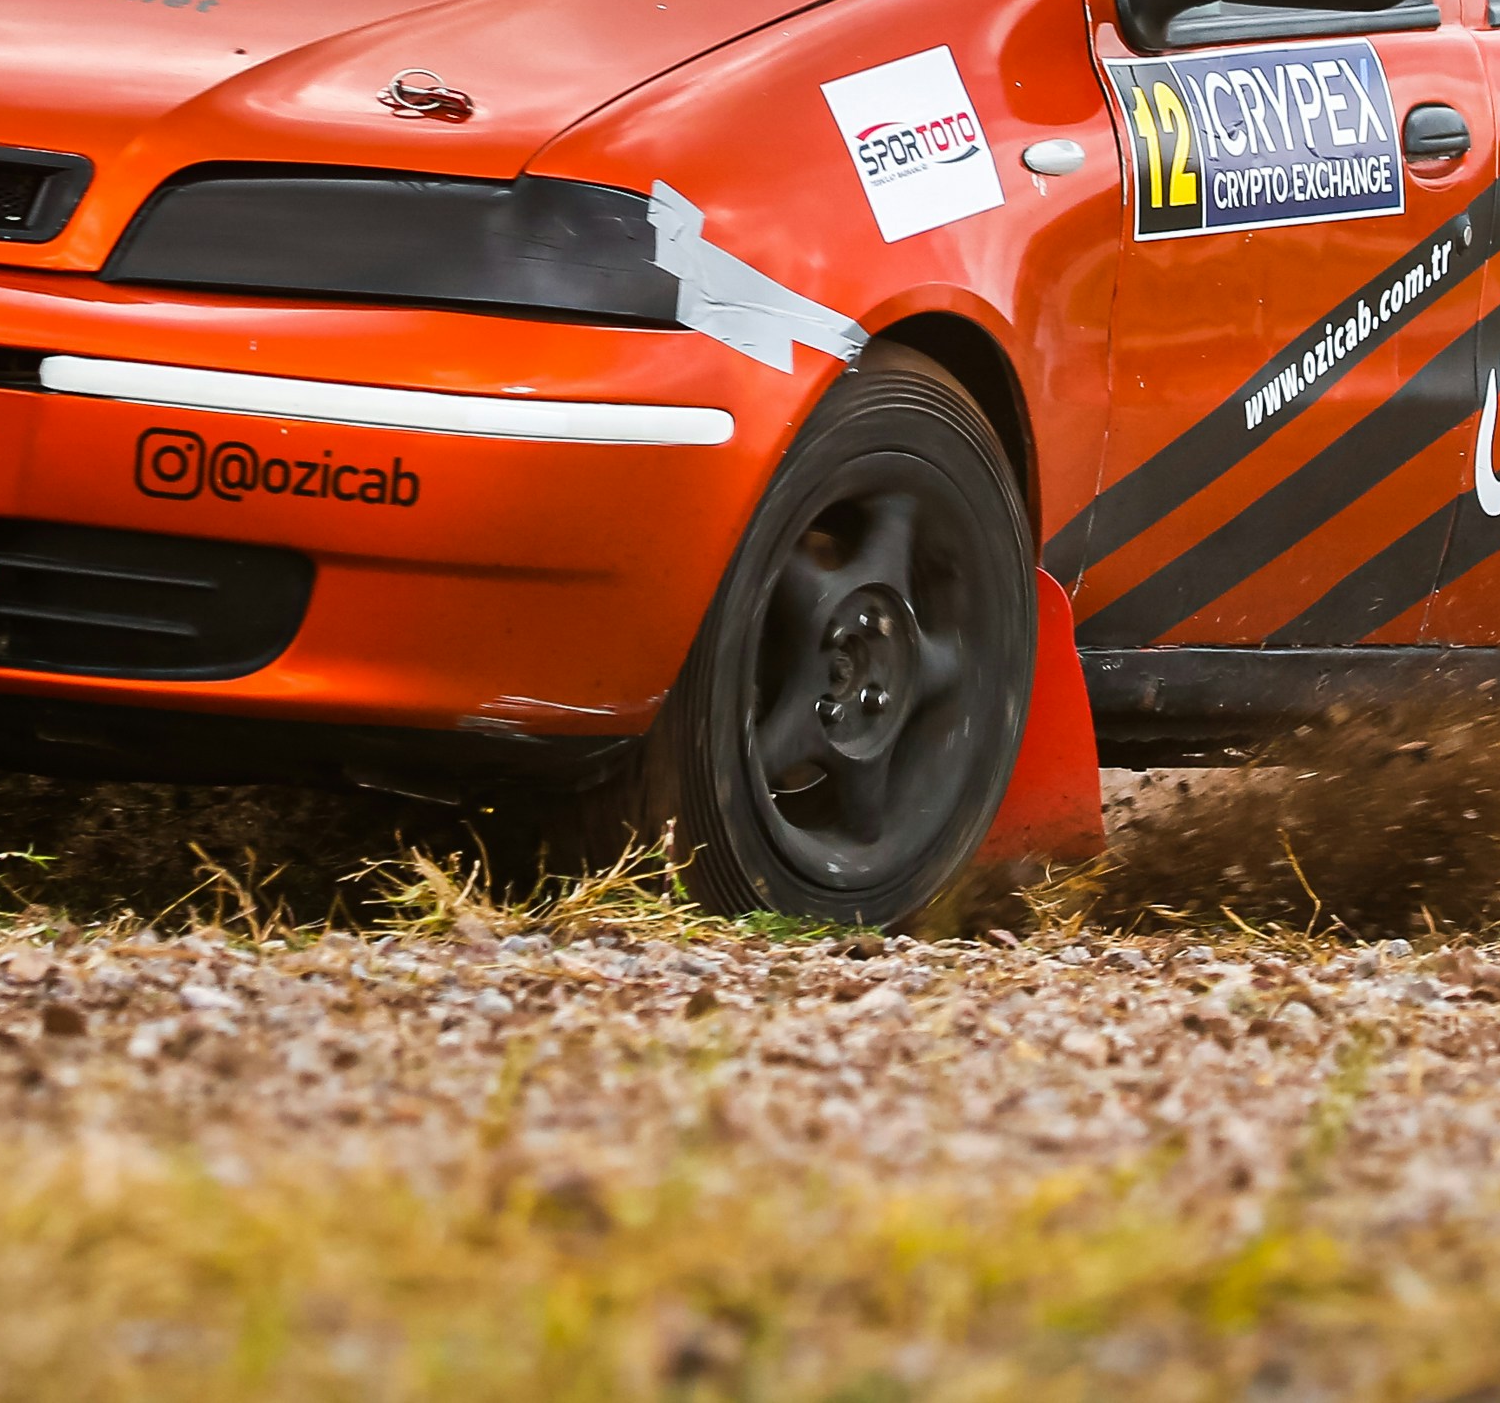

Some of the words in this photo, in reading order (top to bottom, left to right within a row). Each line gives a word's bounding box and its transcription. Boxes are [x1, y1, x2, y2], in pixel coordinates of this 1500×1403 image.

[858, 111, 976, 176] SPORTOTO
[1132, 80, 1197, 209] 12
[1186, 58, 1388, 159] ICRYPEX
[1213, 165, 1289, 211] CRYPTO
[1290, 154, 1393, 202] EXCHANGE
[1243, 239, 1453, 431] www.ozicab.com.tr
[208, 440, 420, 507] @ozicab
